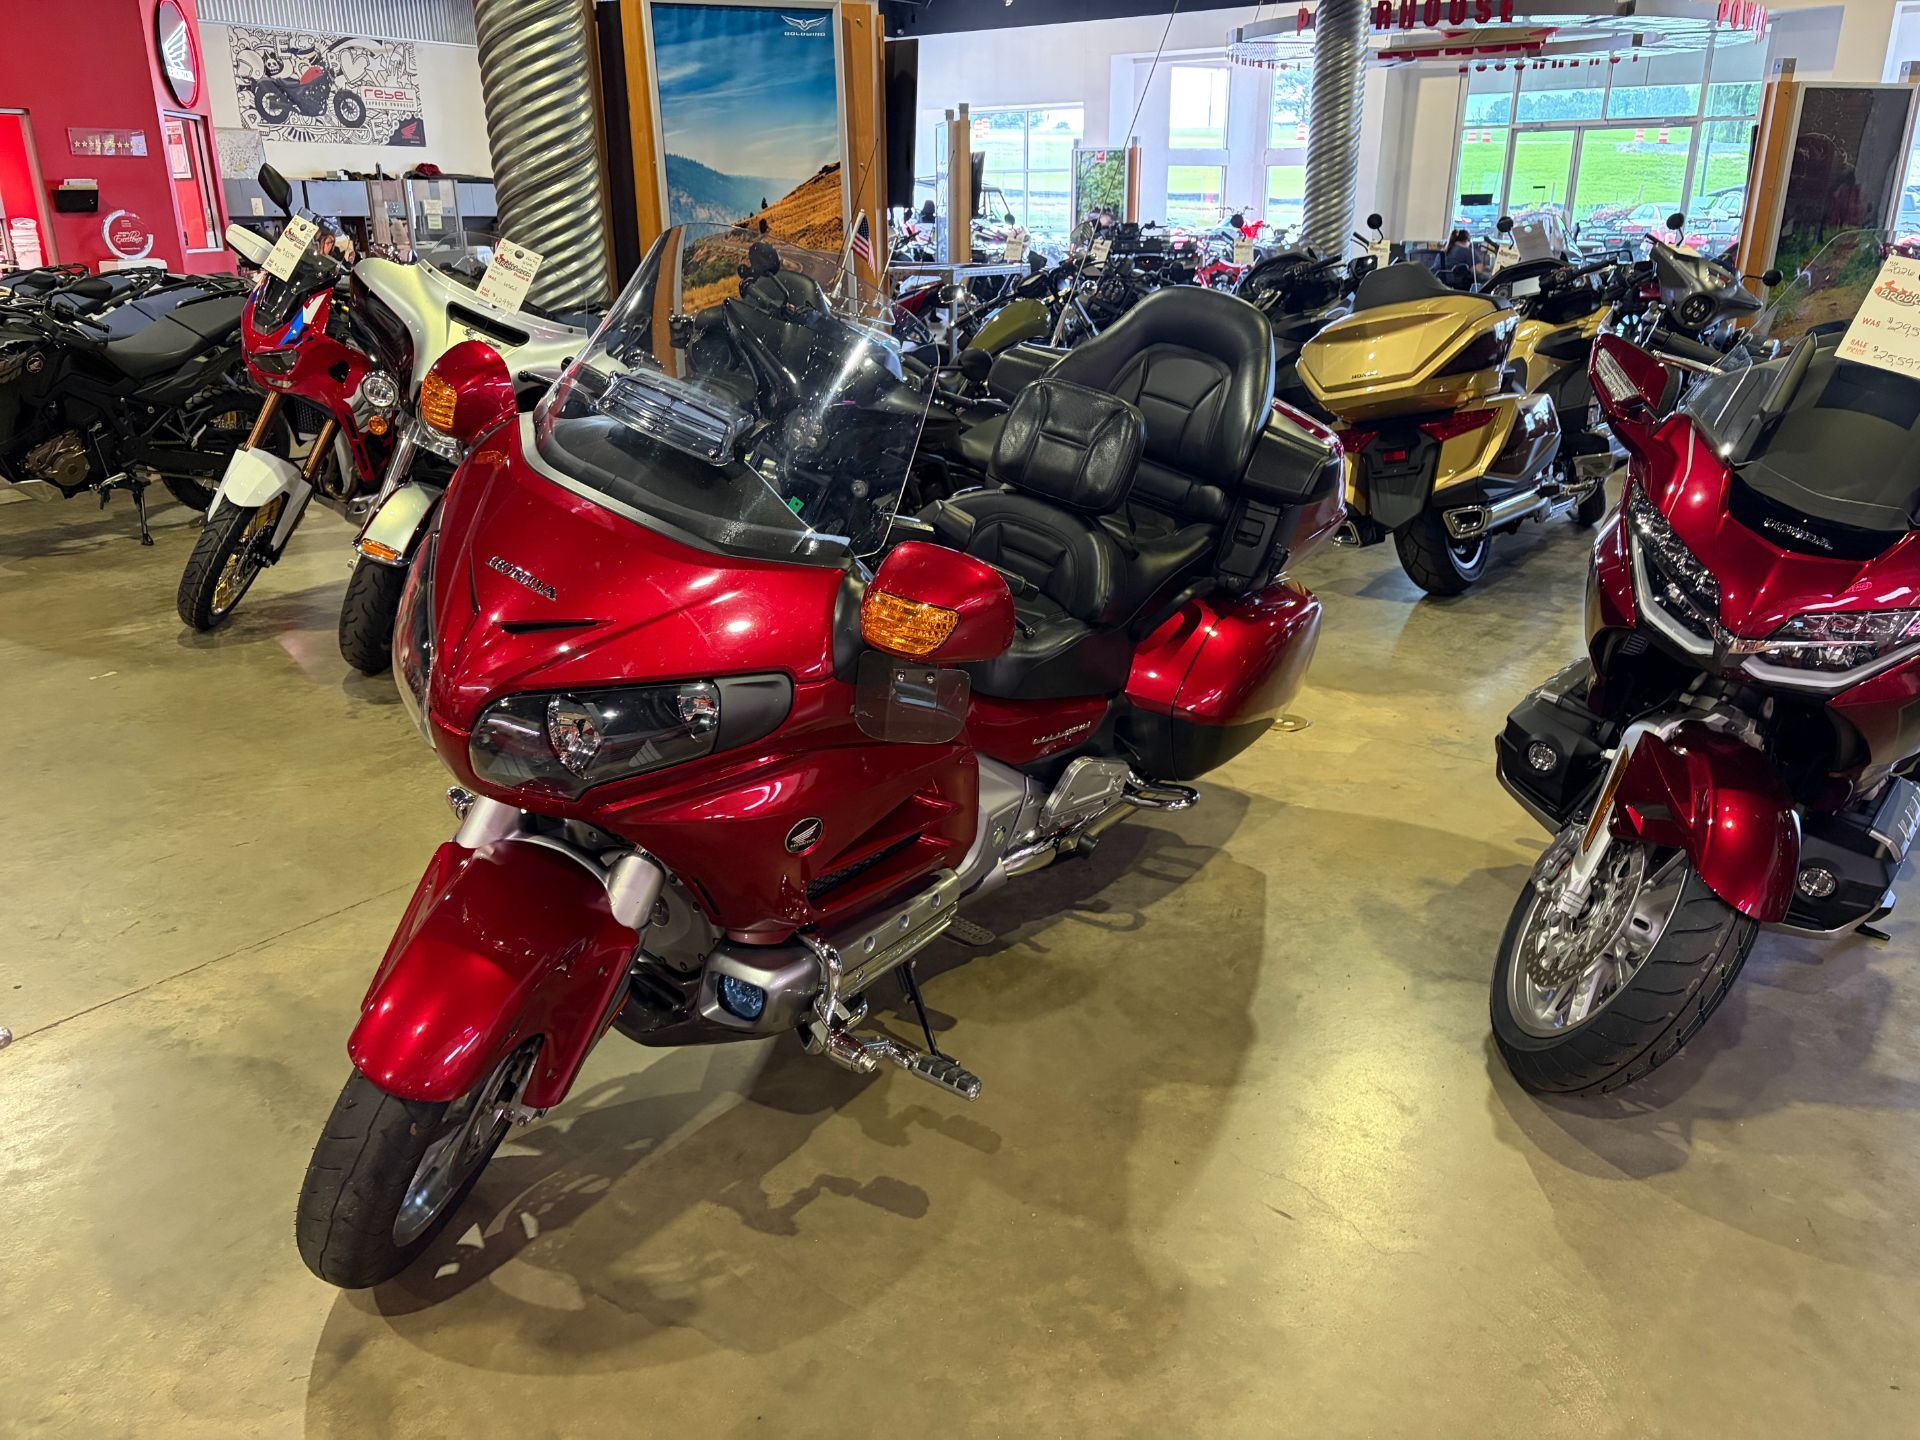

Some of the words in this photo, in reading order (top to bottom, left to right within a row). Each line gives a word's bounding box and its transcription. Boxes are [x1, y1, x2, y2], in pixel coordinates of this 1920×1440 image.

[1296, 0, 1513, 36] PRHOUSE
[1862, 317, 1881, 328] WAS
[1850, 339, 1869, 349] SALE
[1846, 346, 1867, 356] PRICE
[486, 555, 557, 602] HONDA
